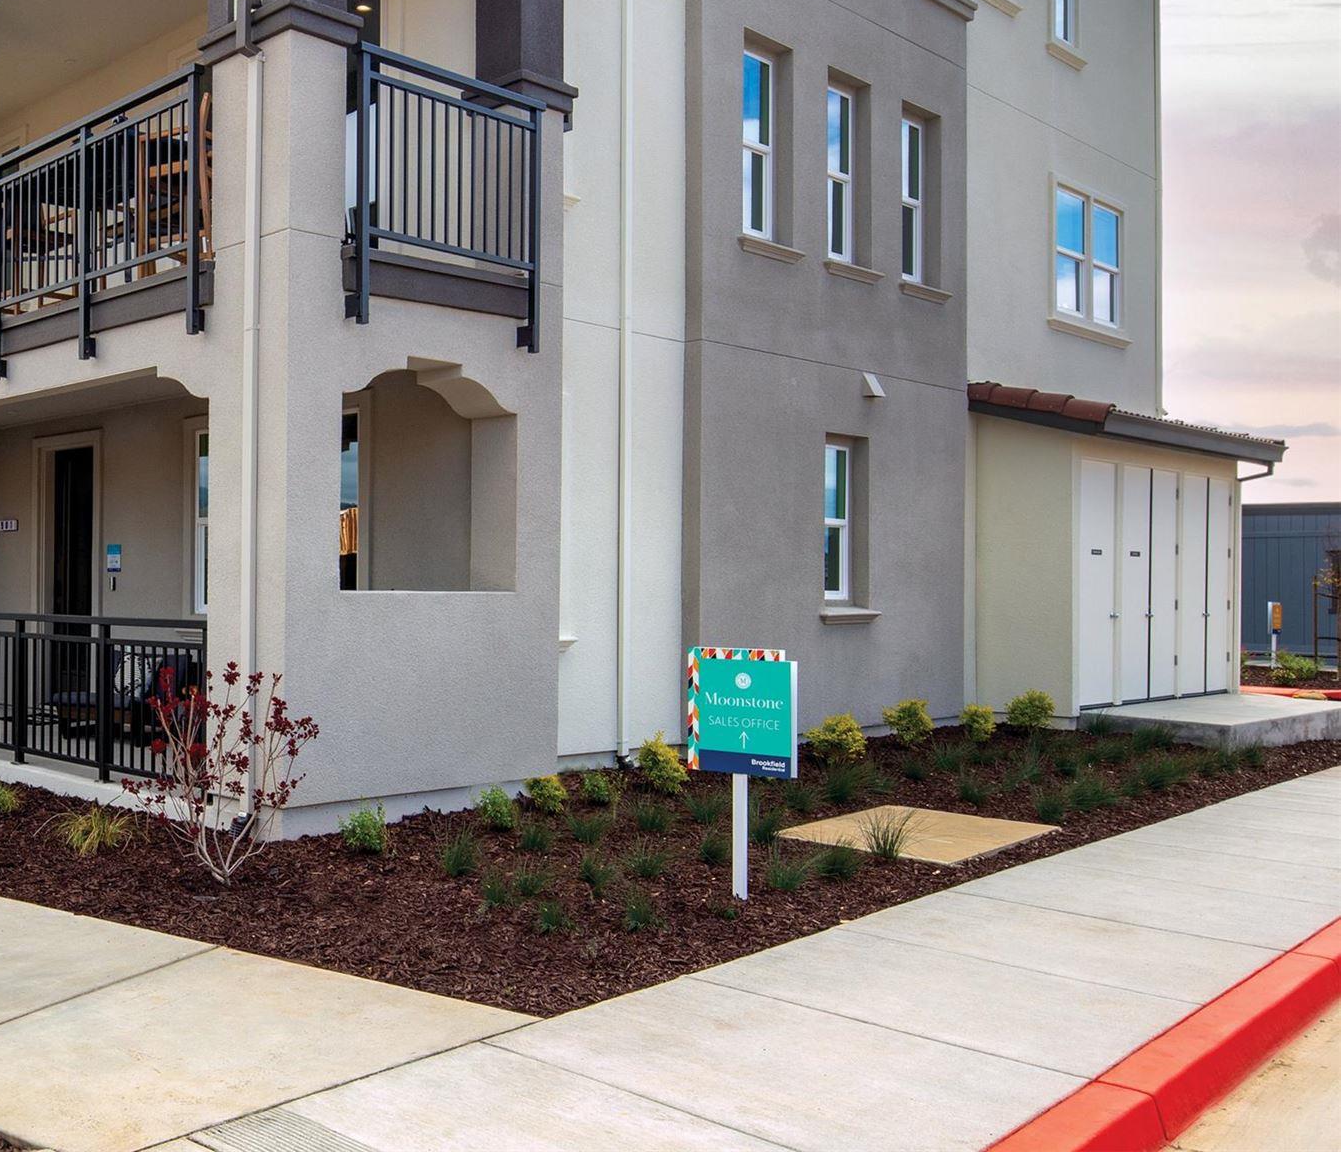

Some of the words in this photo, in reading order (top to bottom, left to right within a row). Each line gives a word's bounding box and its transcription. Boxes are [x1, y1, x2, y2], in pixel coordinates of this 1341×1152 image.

[704, 691, 784, 710] Moonstone
[708, 715, 739, 728] SALES
[741, 718, 780, 731] OFFICE
[751, 758, 786, 768] Brookfield
